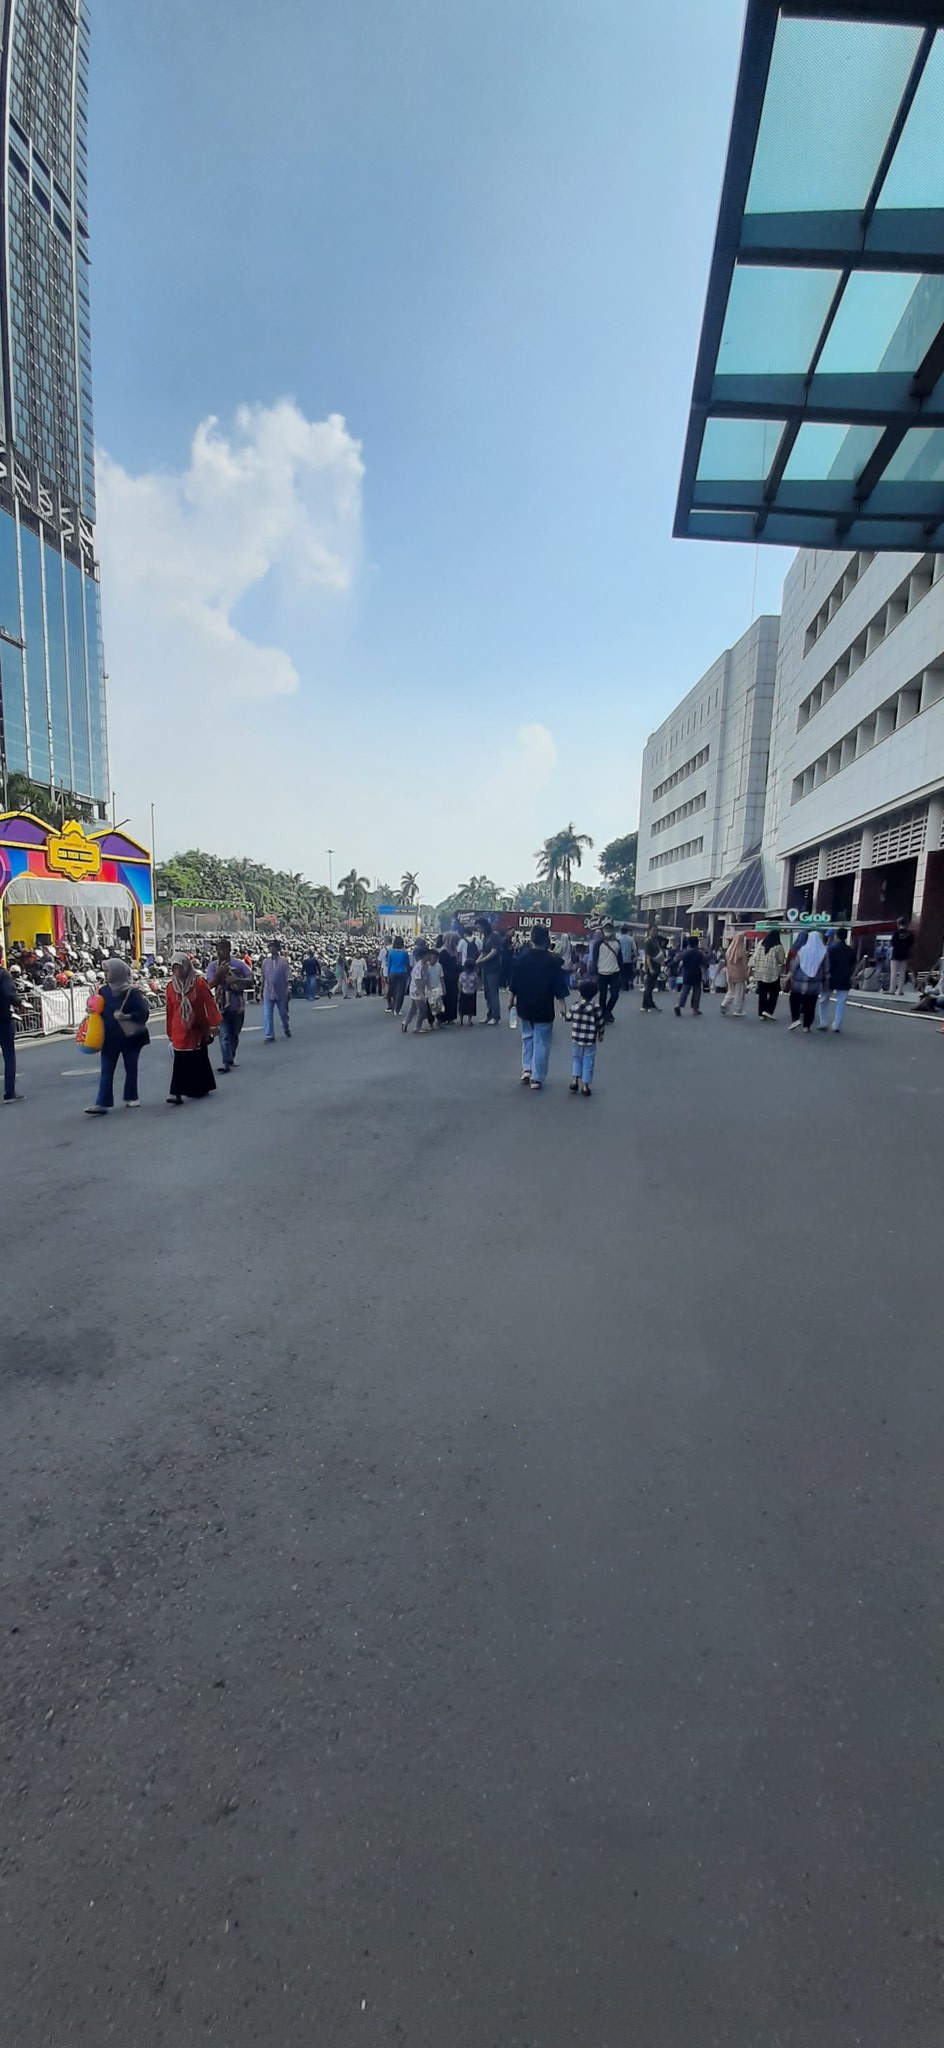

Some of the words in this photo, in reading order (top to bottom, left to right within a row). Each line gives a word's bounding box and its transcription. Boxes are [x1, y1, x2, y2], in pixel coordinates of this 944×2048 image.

[799, 911, 831, 922] Grab
[519, 917, 544, 927] LOKET
[545, 917, 552, 928] 9
